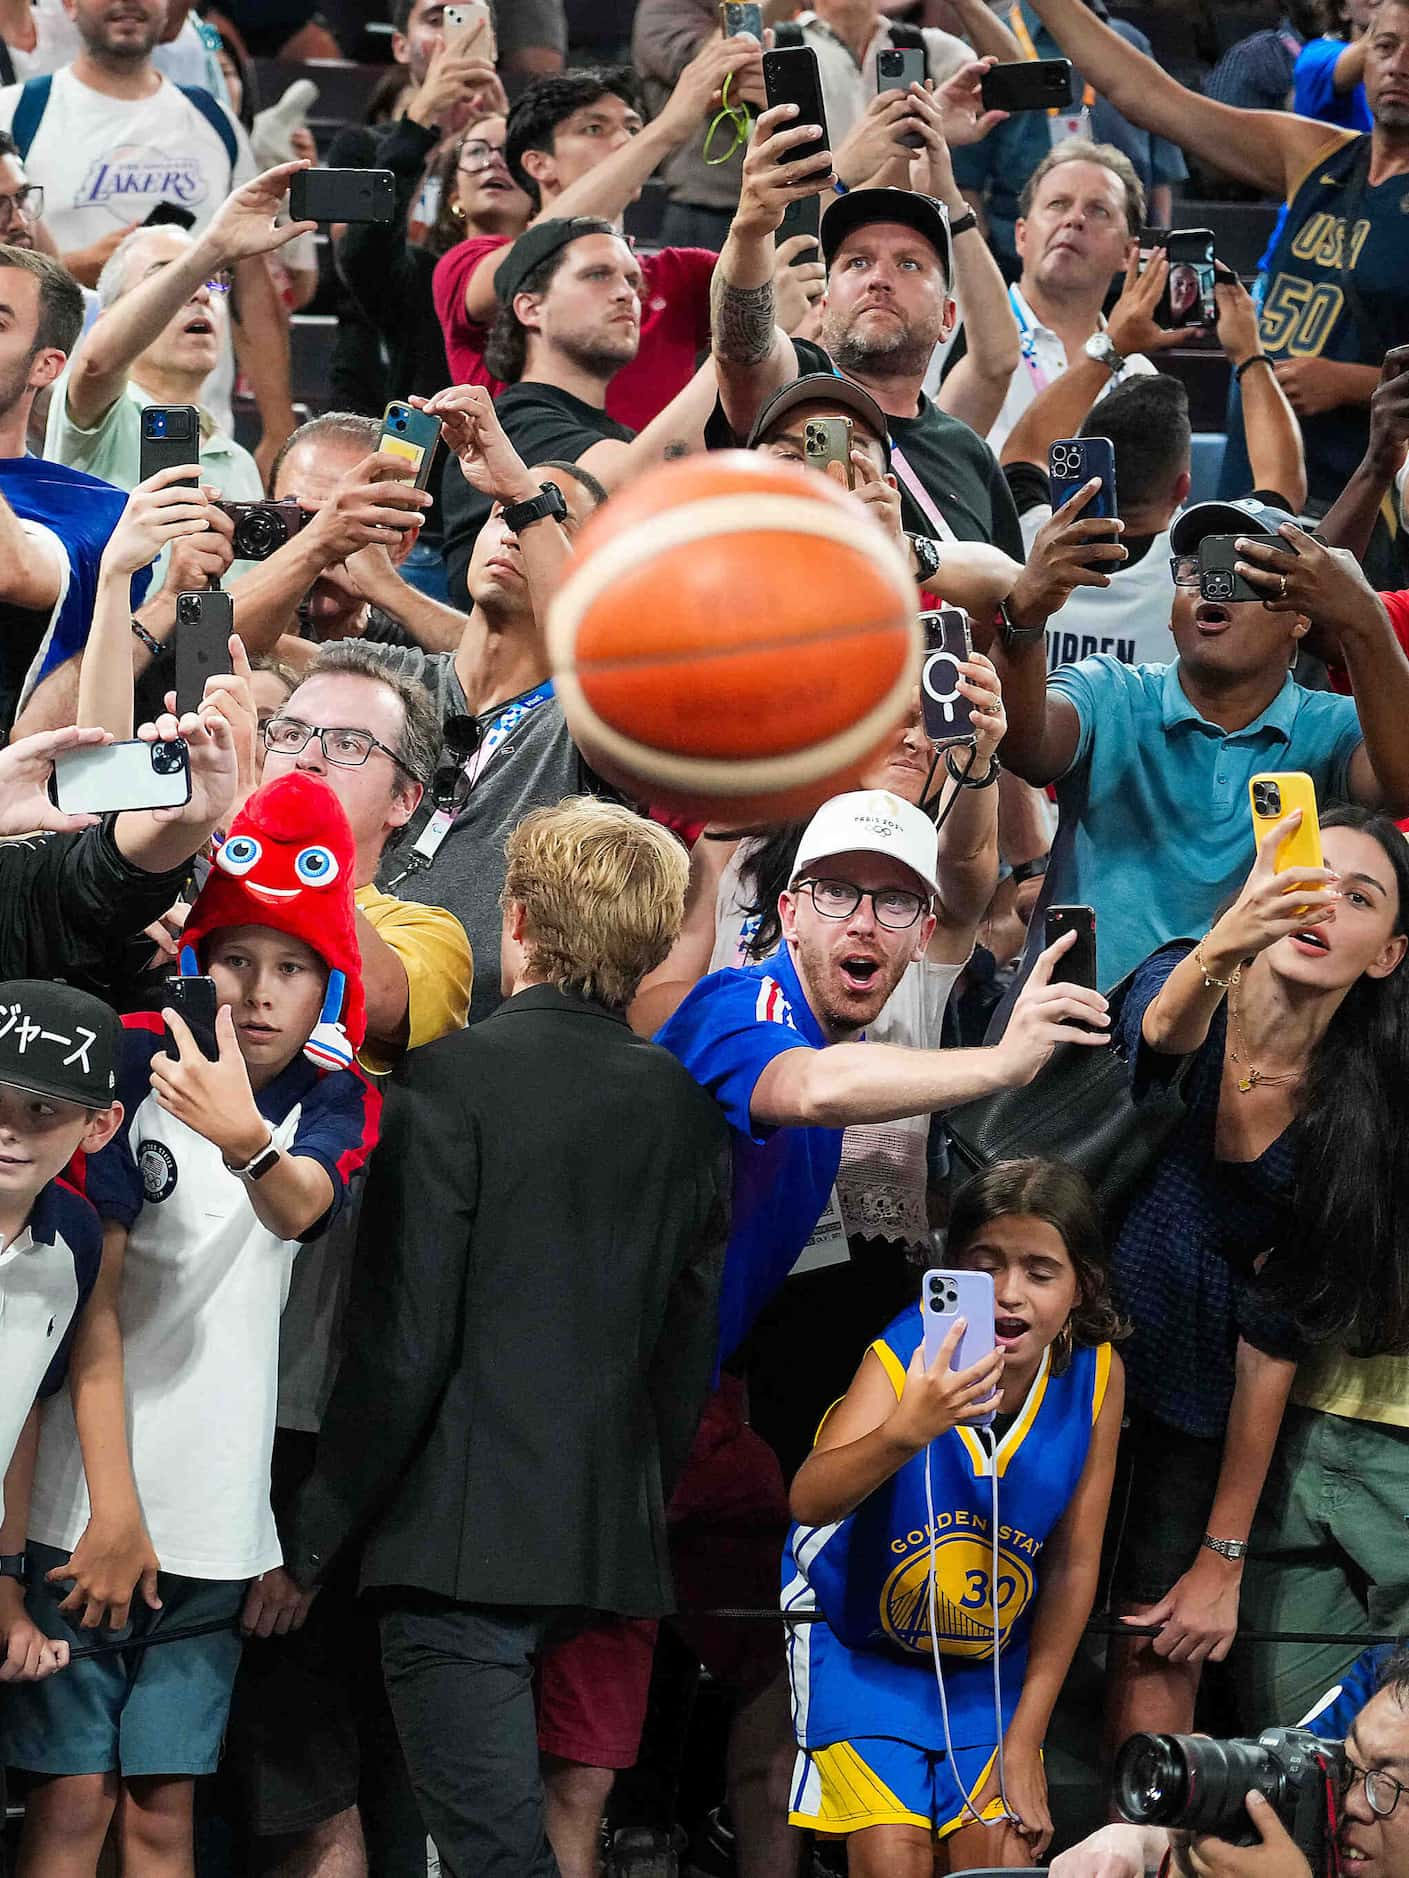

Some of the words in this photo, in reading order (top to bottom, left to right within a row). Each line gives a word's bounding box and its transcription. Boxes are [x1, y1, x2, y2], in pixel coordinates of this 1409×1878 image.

[89, 164, 196, 200] LAKERS
[1258, 272, 1344, 357] 50
[891, 1510, 988, 1554] GOLDEN
[960, 1570, 1016, 1609] 30
